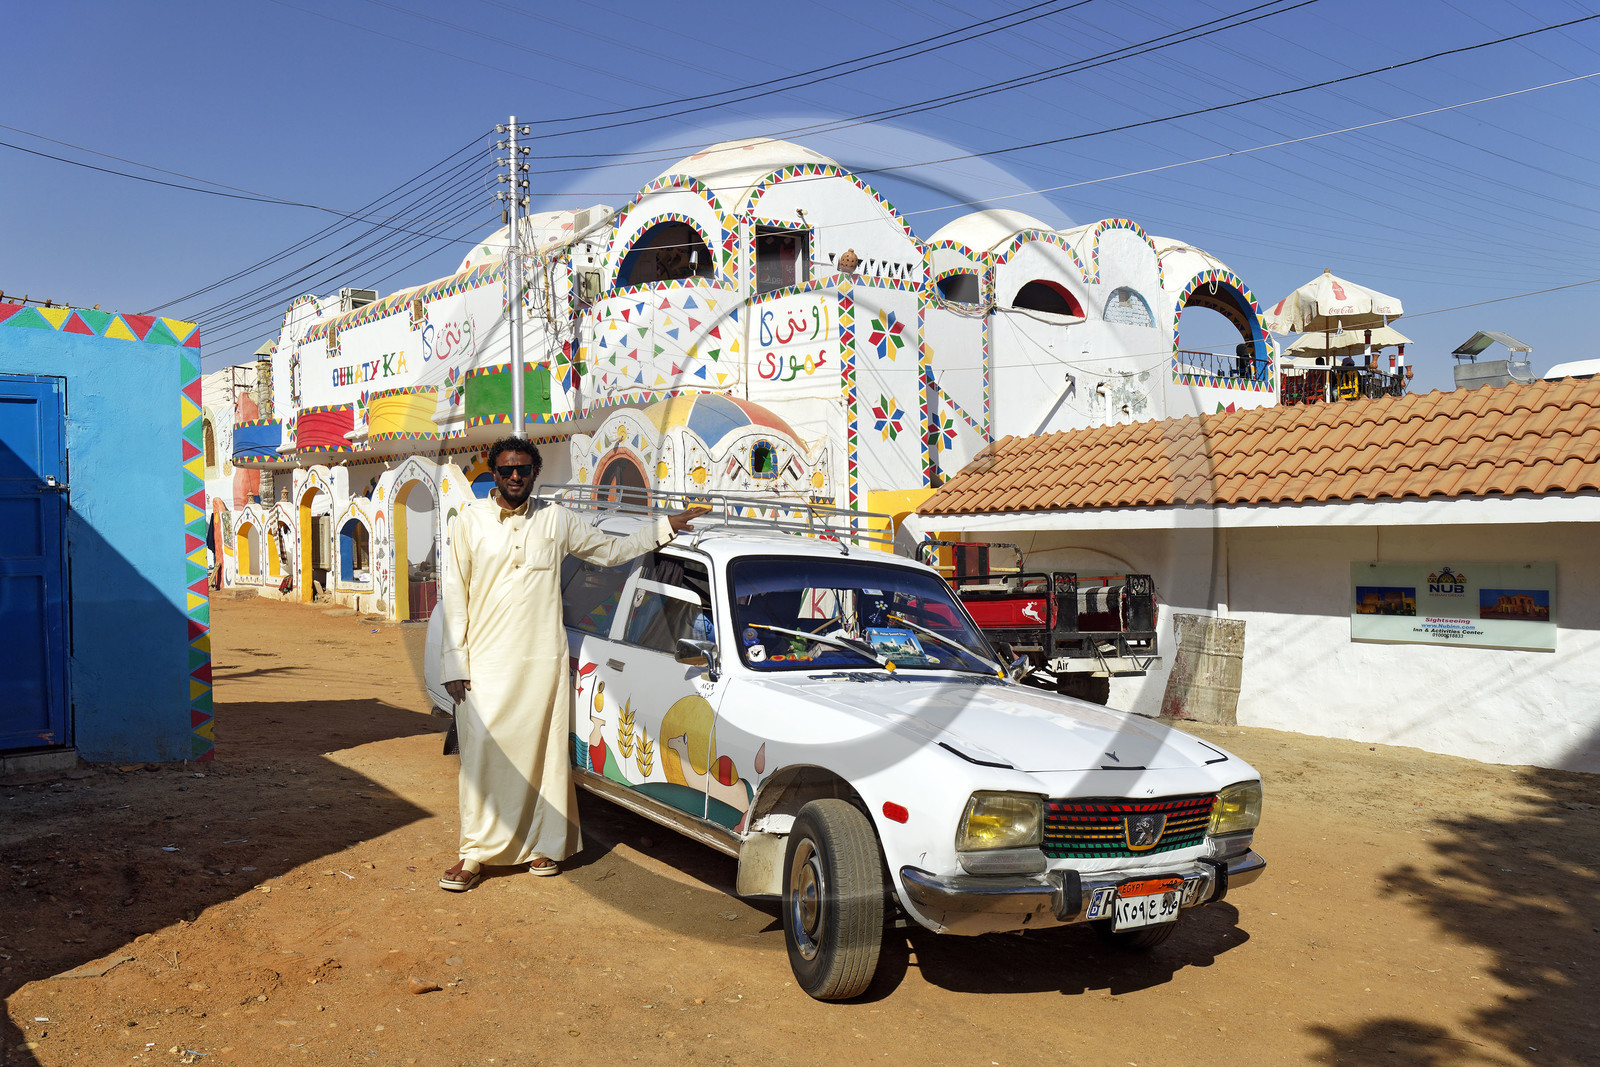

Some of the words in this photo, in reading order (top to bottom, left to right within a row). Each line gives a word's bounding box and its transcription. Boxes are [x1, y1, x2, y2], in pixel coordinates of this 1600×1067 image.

[1429, 584, 1465, 593] NUB
[1056, 659, 1070, 671] Air
[1122, 883, 1145, 894] EGYPT
[1091, 906, 1098, 914] D
